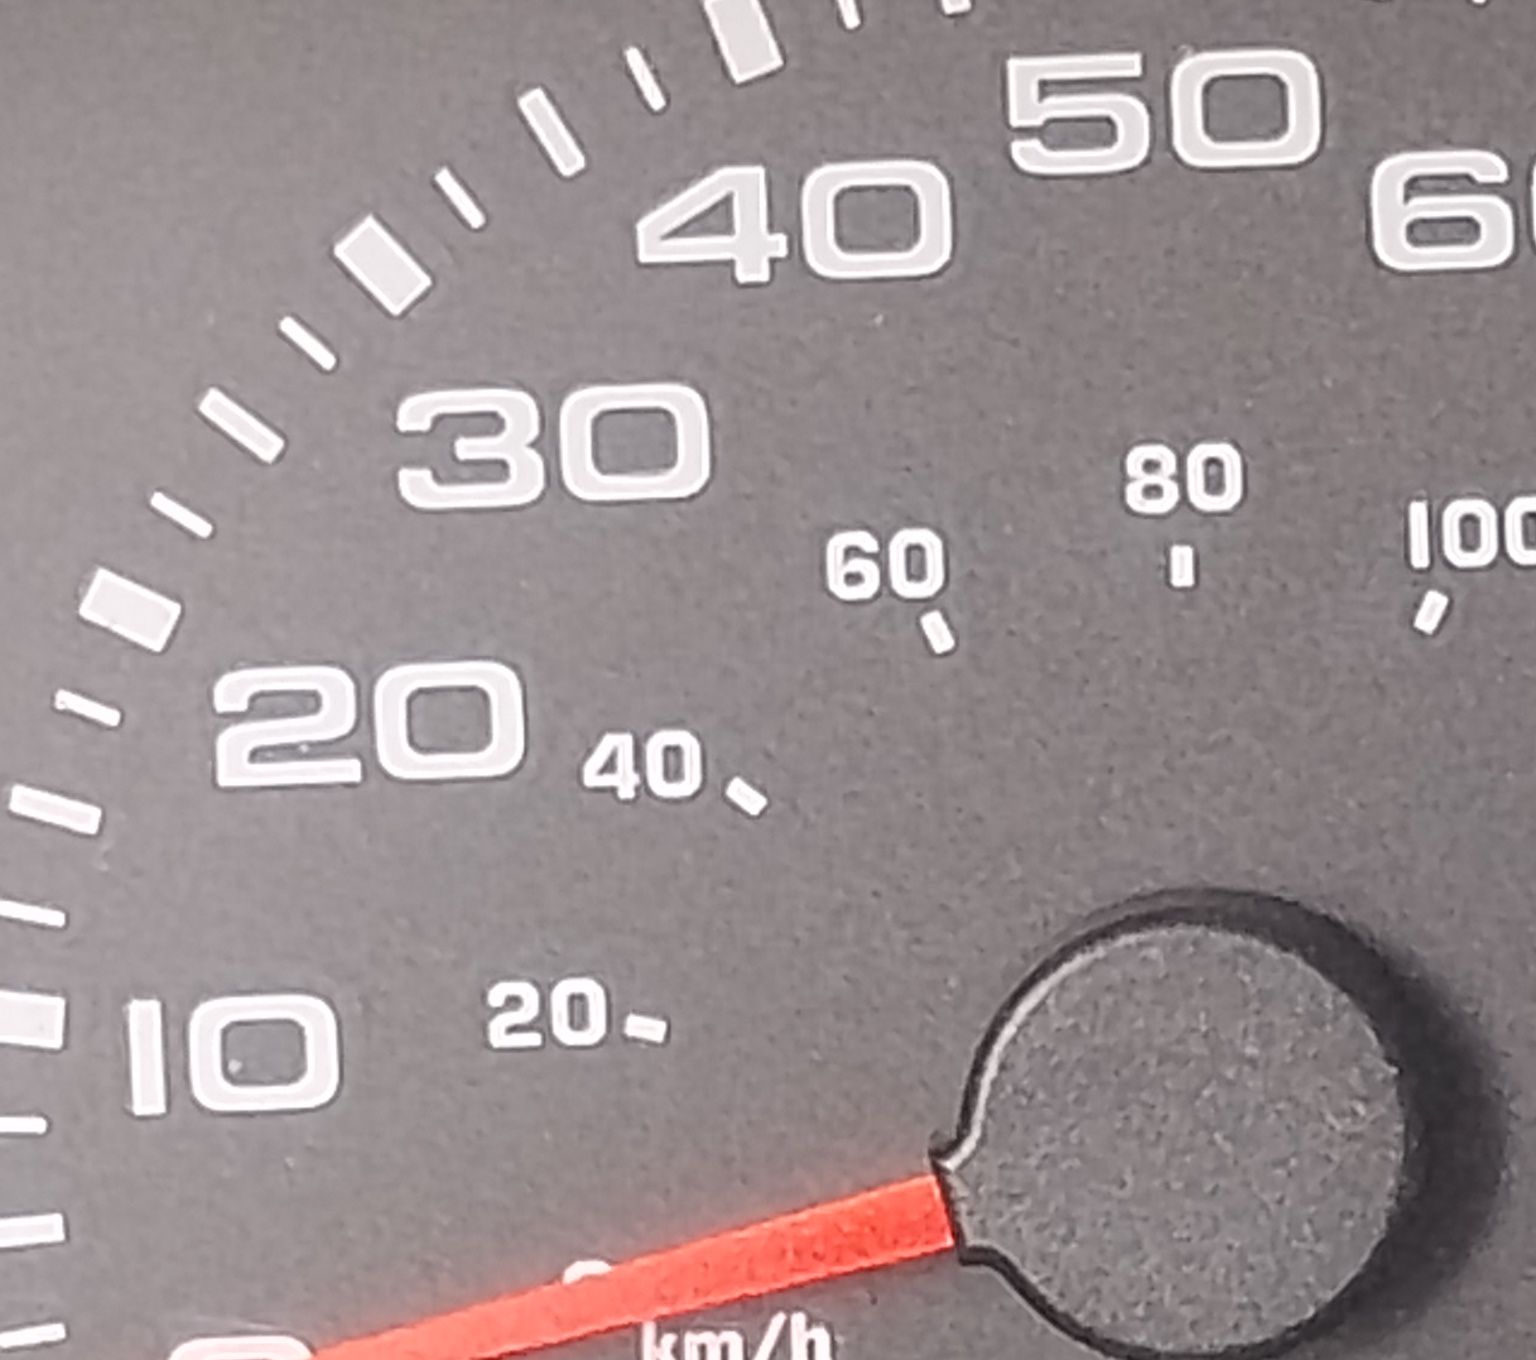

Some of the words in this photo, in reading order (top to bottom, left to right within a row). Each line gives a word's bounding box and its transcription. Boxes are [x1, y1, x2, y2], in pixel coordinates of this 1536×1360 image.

[1005, 47, 1322, 169] 50
[633, 158, 954, 285] 40
[395, 381, 712, 510] 30
[1124, 440, 1244, 516] 80
[824, 526, 946, 602] 60
[212, 659, 526, 788] 20
[581, 728, 703, 802] 40
[126, 993, 340, 1117] 10
[486, 976, 608, 1051] 20
